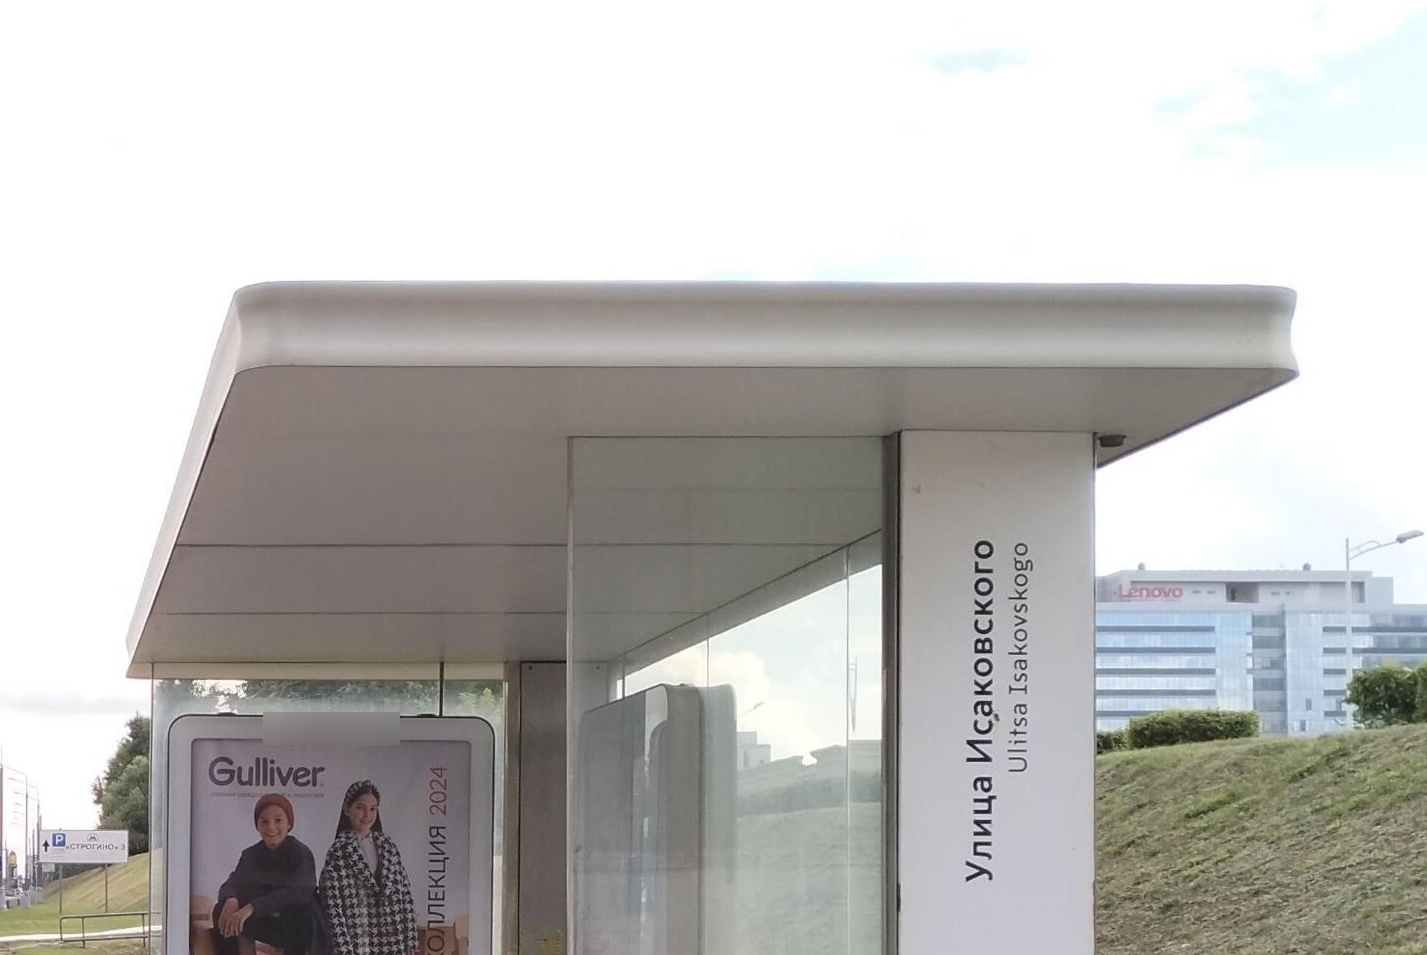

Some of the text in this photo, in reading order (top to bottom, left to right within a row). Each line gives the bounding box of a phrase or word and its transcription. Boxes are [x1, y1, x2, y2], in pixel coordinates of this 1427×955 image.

[1118, 583, 1183, 598] Lenovo
[1007, 542, 1033, 772] Ulitsa Isakovskogo
[965, 540, 997, 882] Улица Исаковского
[208, 756, 325, 787] Gulliver
[429, 767, 447, 816] 2024
